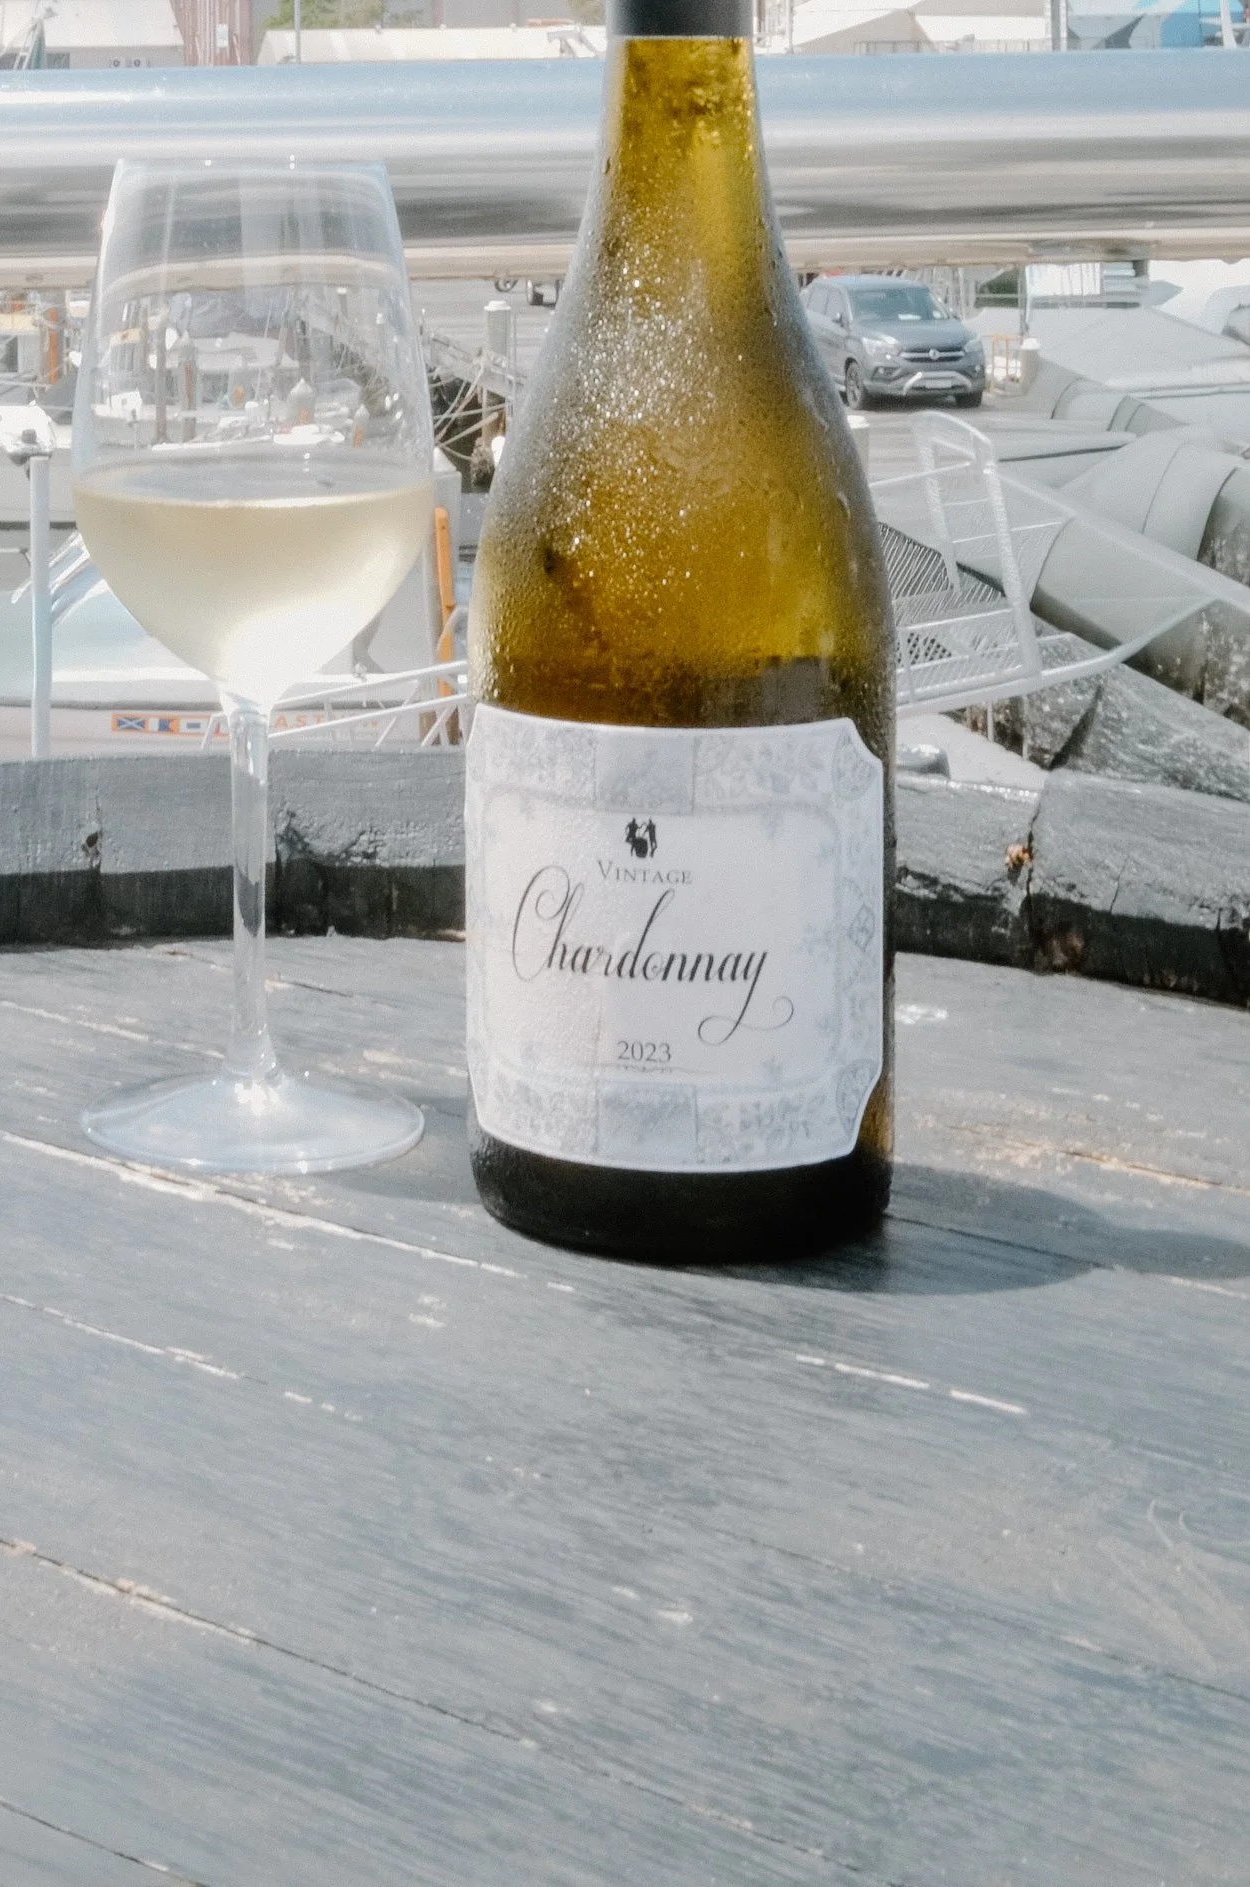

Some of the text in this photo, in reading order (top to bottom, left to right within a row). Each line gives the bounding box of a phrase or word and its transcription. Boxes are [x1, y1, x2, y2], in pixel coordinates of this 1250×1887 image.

[597, 859, 692, 885] VINTAGE
[512, 864, 795, 1046] Chardonnay
[617, 1040, 671, 1063] 2023
